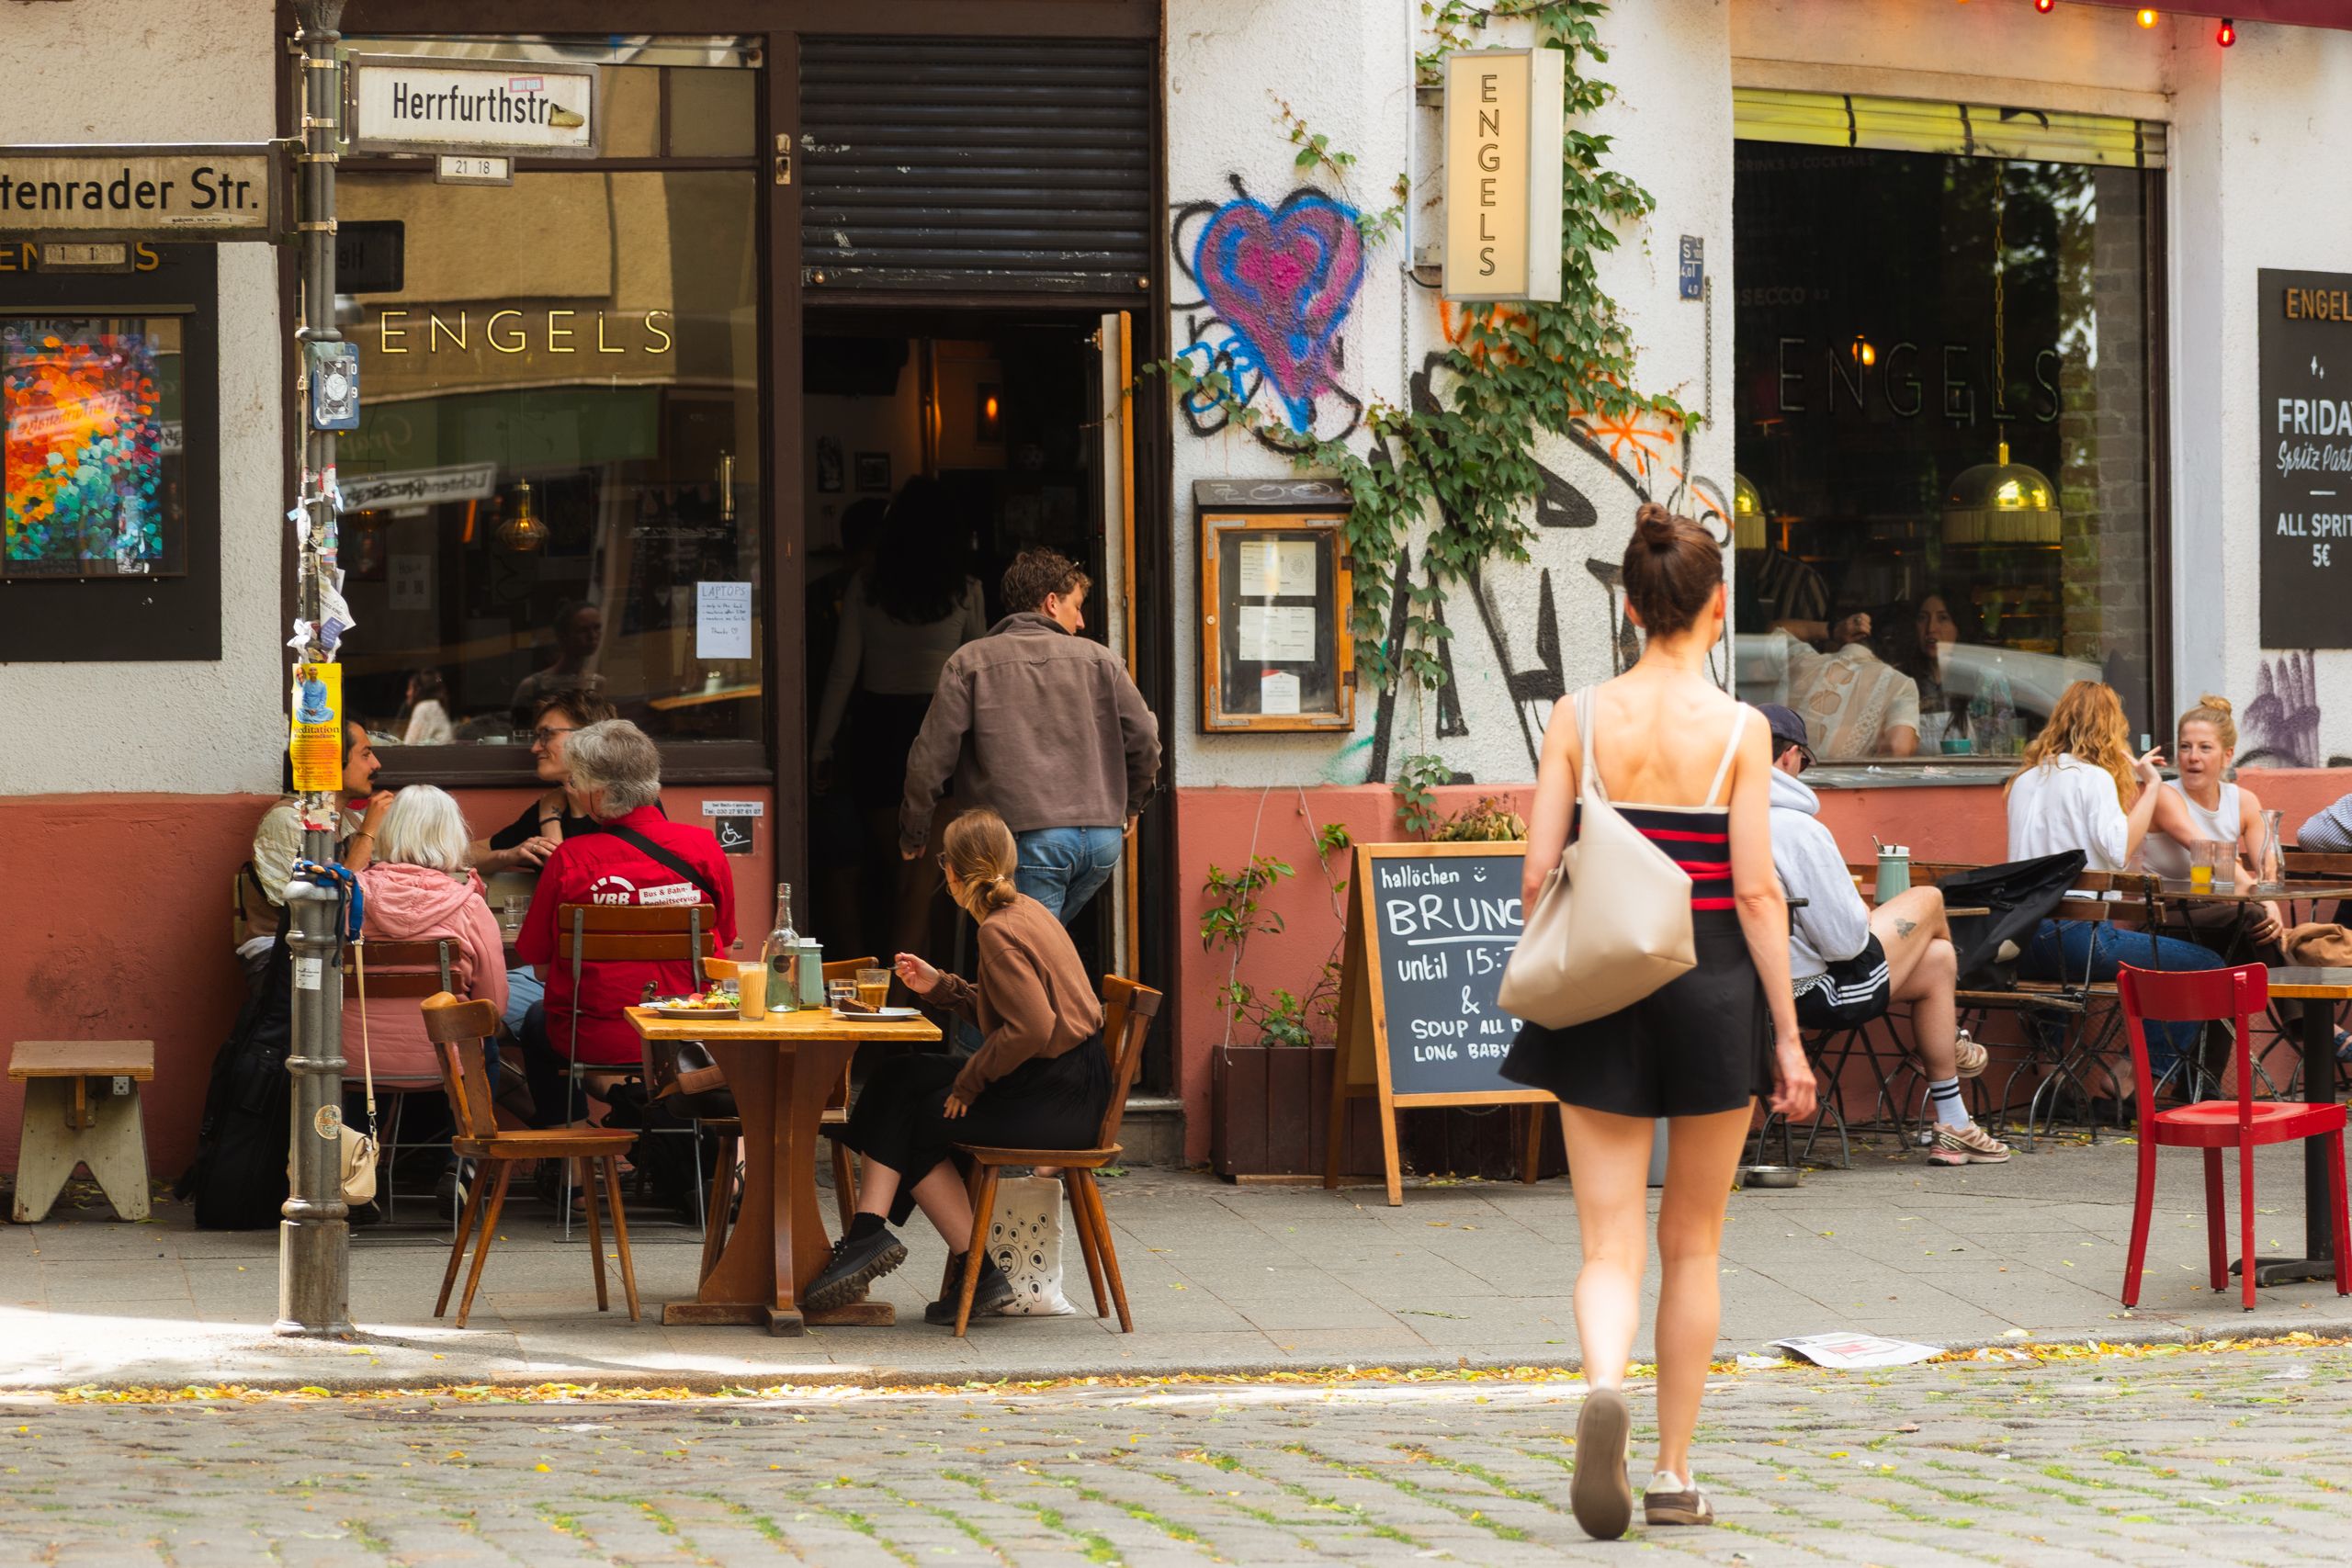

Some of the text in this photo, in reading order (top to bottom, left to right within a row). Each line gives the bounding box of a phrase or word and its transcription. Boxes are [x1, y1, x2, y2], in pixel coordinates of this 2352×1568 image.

[456, 160, 491, 175] 21 18
[1477, 73, 1500, 276] ENGELS
[0, 167, 258, 209] tenrader Str.
[379, 309, 672, 355] ENGELS
[1778, 335, 2062, 423] ENGELS
[2278, 398, 2352, 436] FRIDA
[2277, 441, 2352, 480] Spritz Part
[2277, 513, 2307, 536] ALL
[2312, 544, 2331, 567] 5€
[702, 586, 746, 597] LAPTOPS
[1381, 863, 1460, 888] hallöchen
[593, 892, 631, 906] VBB
[1397, 947, 1517, 982] until 15:
[1461, 985, 1481, 1015] &
[1410, 1019, 1469, 1039] SOUP
[1479, 1019, 1506, 1034] ALL
[1413, 1043, 1514, 1062] LONG BABY
